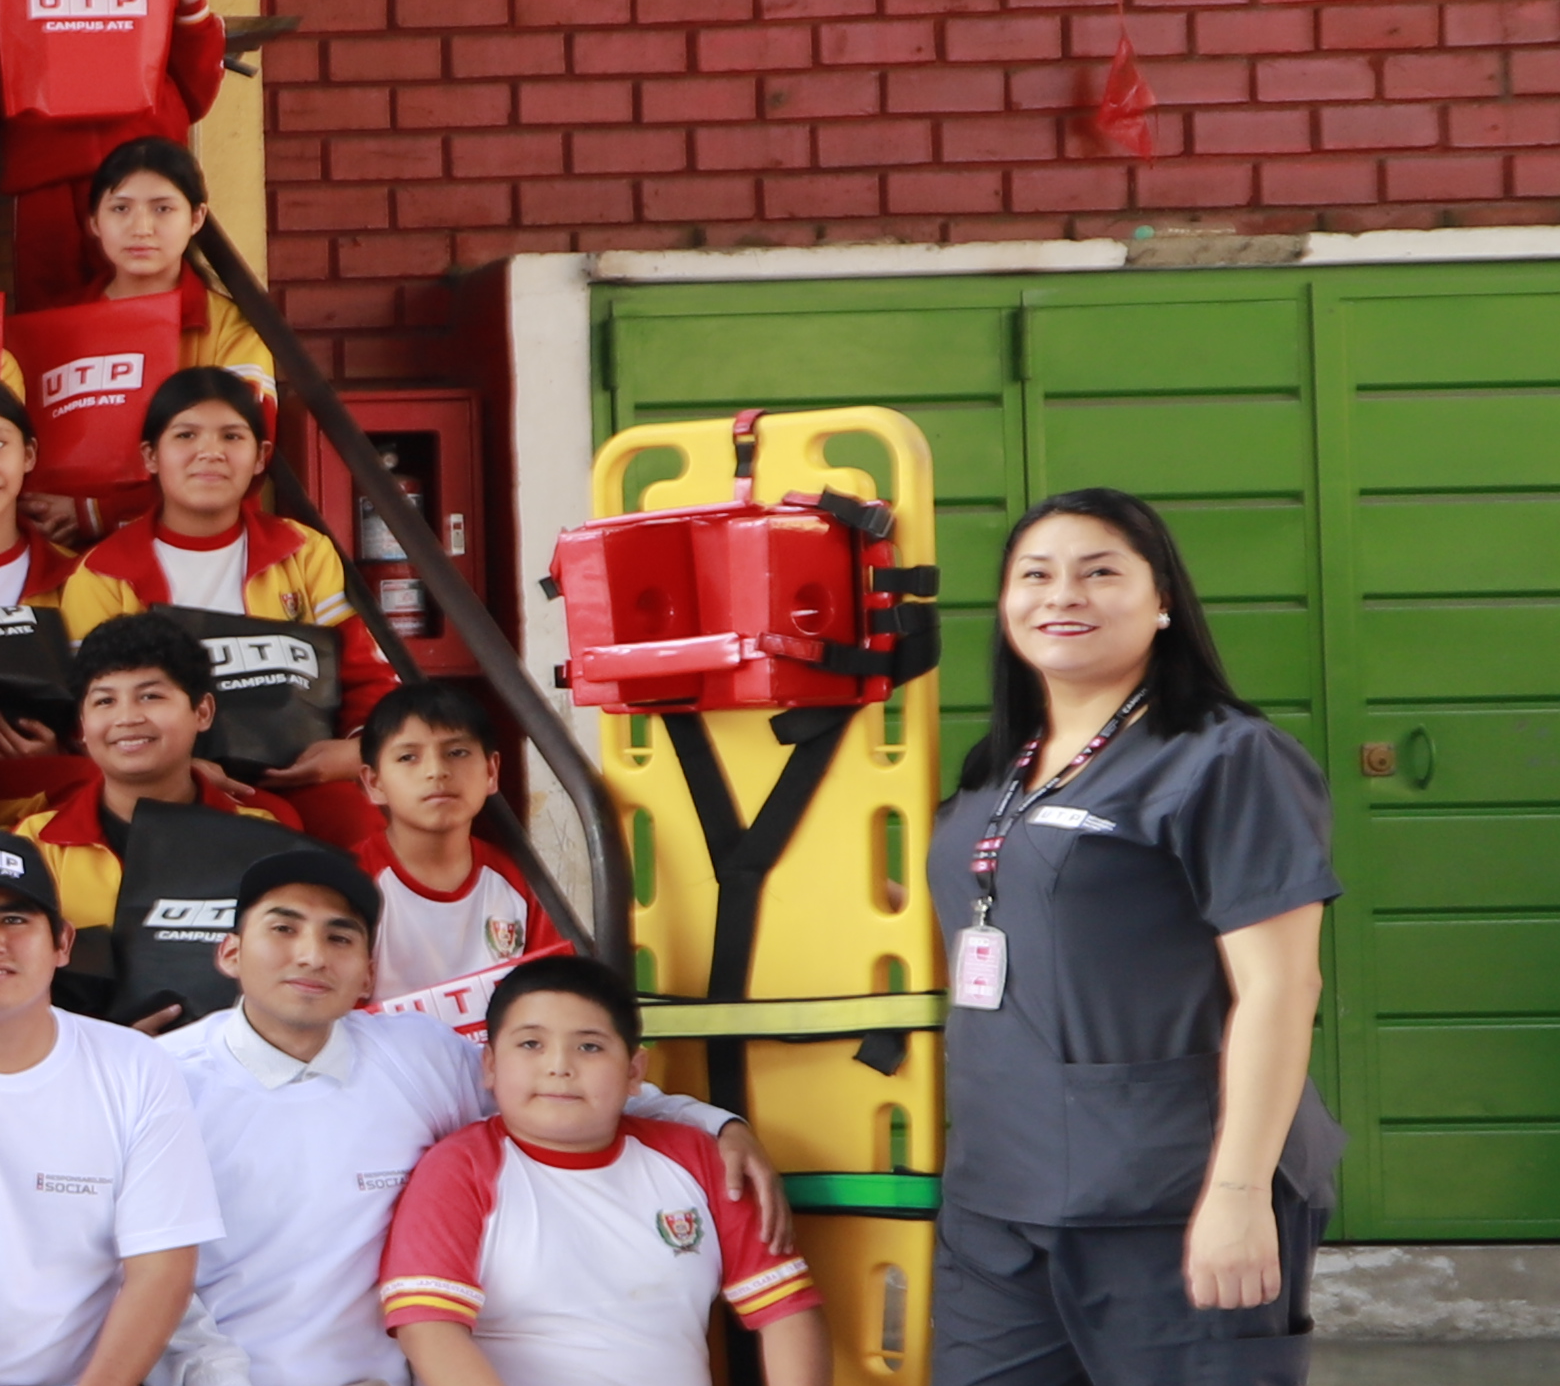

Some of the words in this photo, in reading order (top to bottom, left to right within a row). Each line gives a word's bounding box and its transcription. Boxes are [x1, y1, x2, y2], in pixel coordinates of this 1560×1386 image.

[46, 20, 105, 32] CAMPUS
[107, 20, 134, 31] ATE
[48, 361, 134, 398] UTP
[52, 397, 96, 418] CAMPUS
[98, 393, 126, 406] ATE
[5, 624, 35, 636] ATE
[210, 642, 310, 667] UTP
[221, 673, 287, 690] CAMPUS
[289, 675, 311, 690] ATE
[157, 929, 228, 944] CAMPUS
[45, 1182, 99, 1195] SOCIAL
